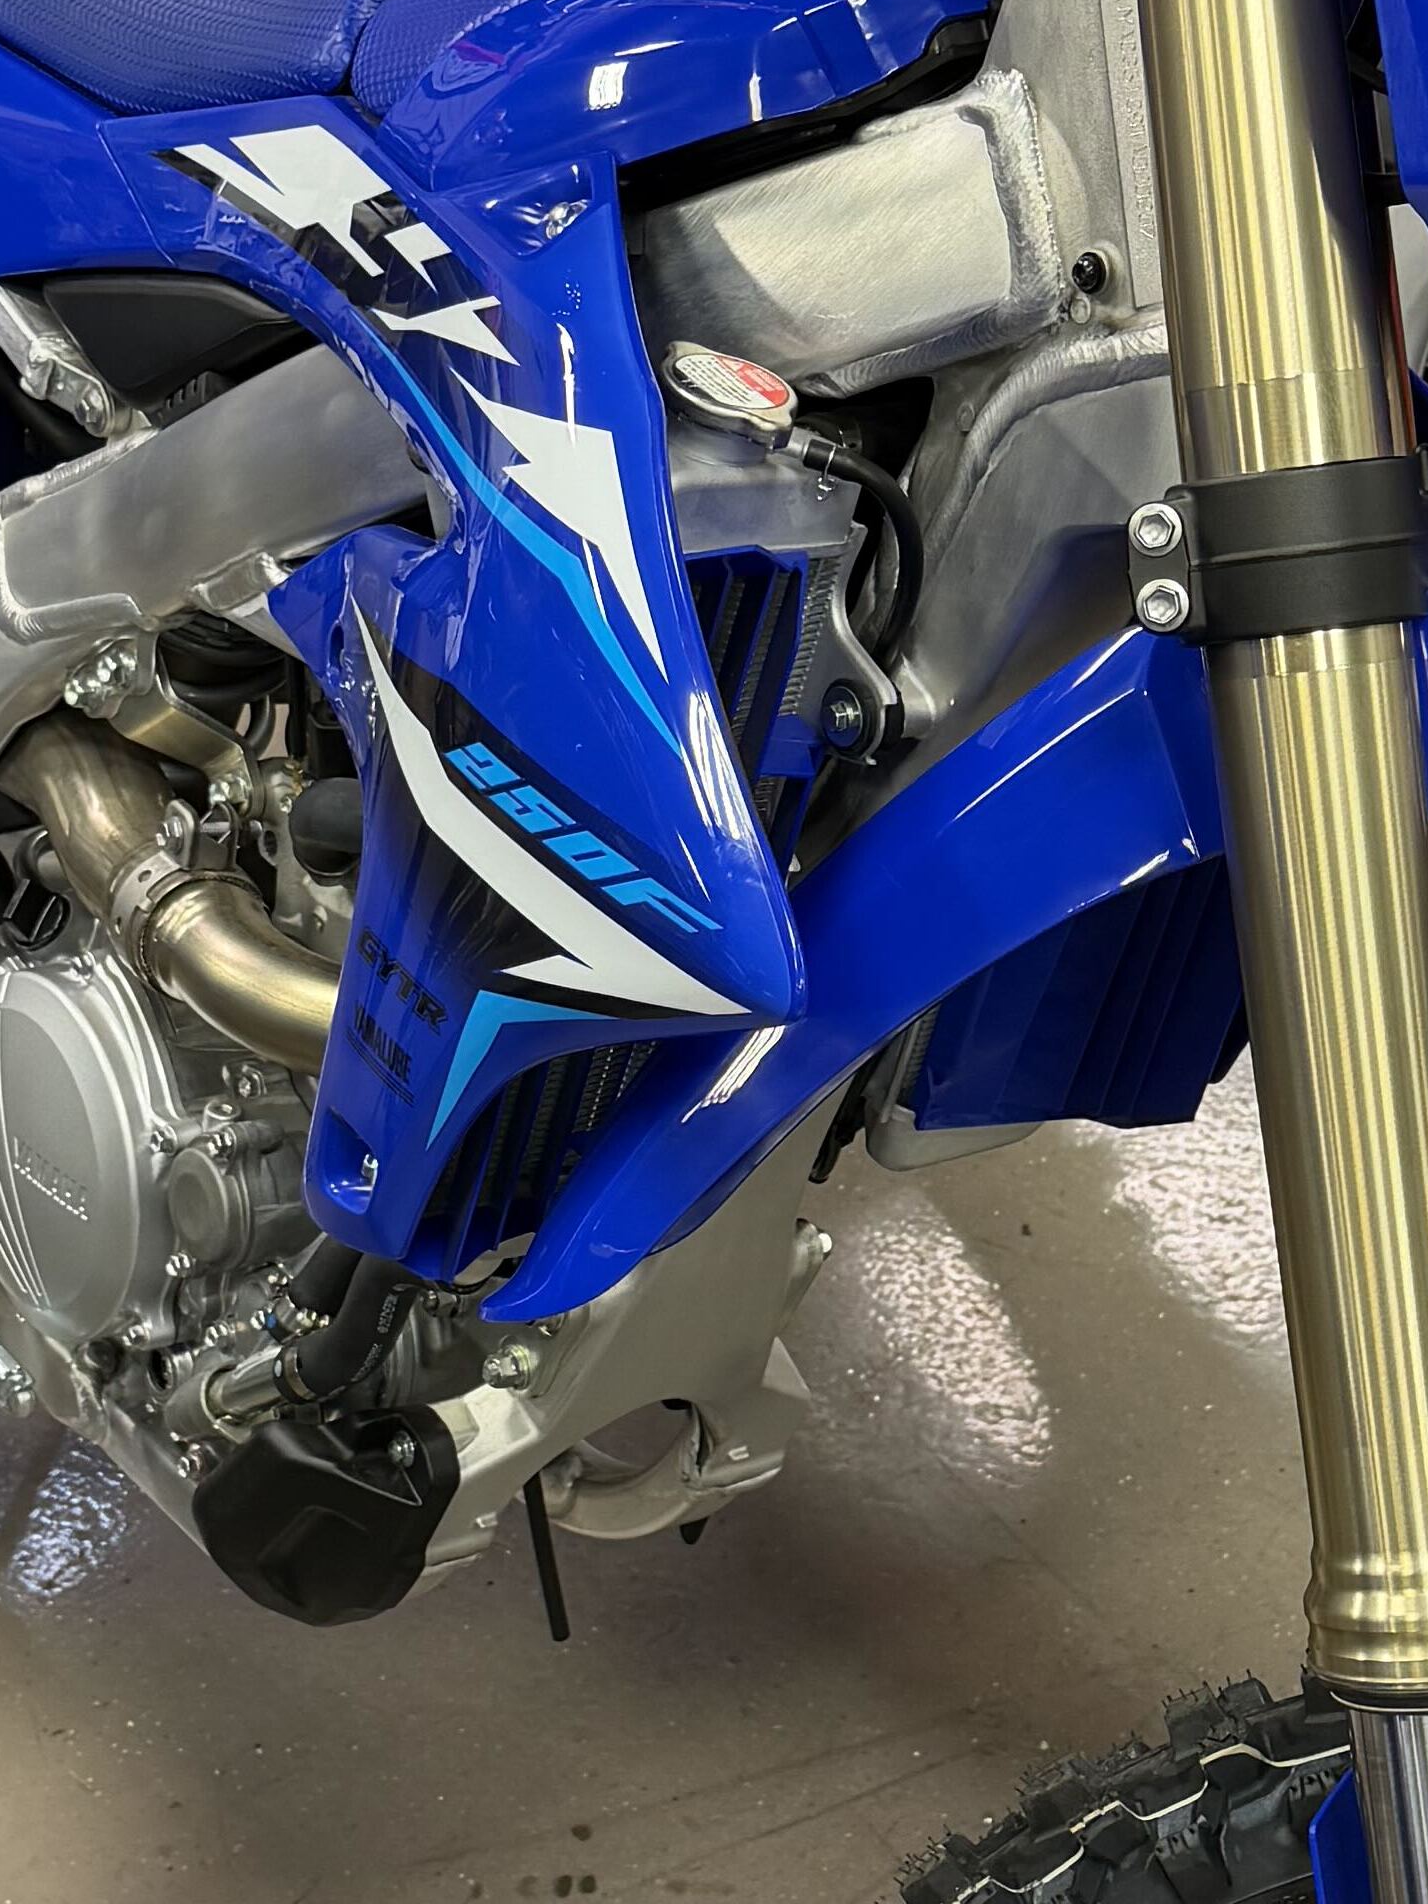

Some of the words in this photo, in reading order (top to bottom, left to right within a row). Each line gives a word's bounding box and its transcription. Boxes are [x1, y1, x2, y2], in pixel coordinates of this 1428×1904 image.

[445, 741, 725, 934] 250F
[357, 926, 449, 1036] GYTR
[352, 1005, 413, 1086] YAMALUBE
[12, 1136, 89, 1222] YAMAHA
